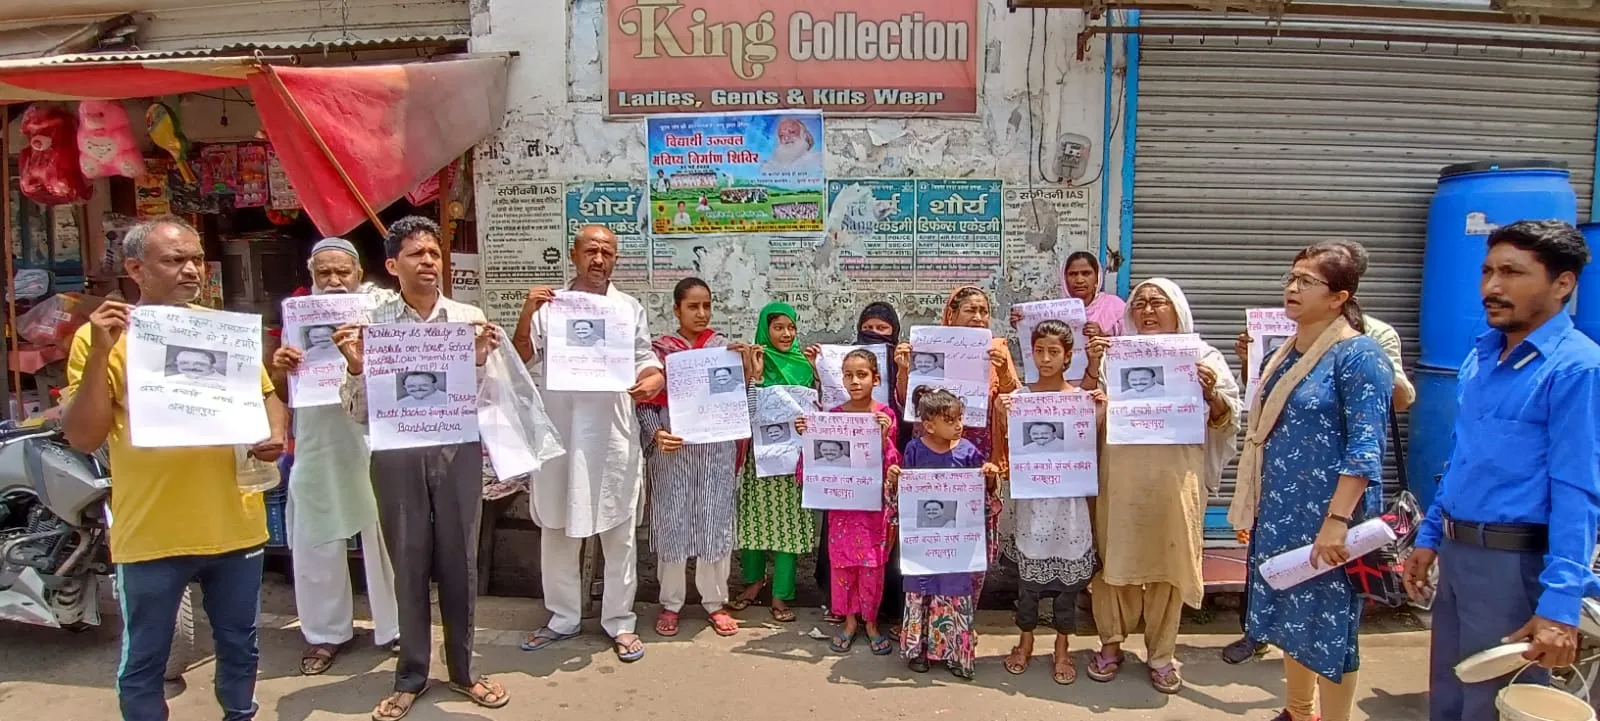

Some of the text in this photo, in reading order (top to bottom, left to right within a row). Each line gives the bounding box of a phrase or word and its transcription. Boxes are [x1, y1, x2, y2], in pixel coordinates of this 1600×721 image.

[618, 4, 968, 80] King Collection
[618, 88, 943, 108] Ladies, Gents & Kids Wear
[706, 135, 743, 146] उज्ज्वल
[688, 150, 722, 164] निर्माण
[727, 149, 759, 163] शिविर
[498, 185, 557, 196] संजीवनी IAS
[1066, 190, 1084, 199] IAS
[579, 194, 636, 216] शौर्य
[929, 193, 989, 214] शौर्य
[918, 216, 956, 232] डिफेन्स
[959, 217, 1000, 232] एकेडमी
